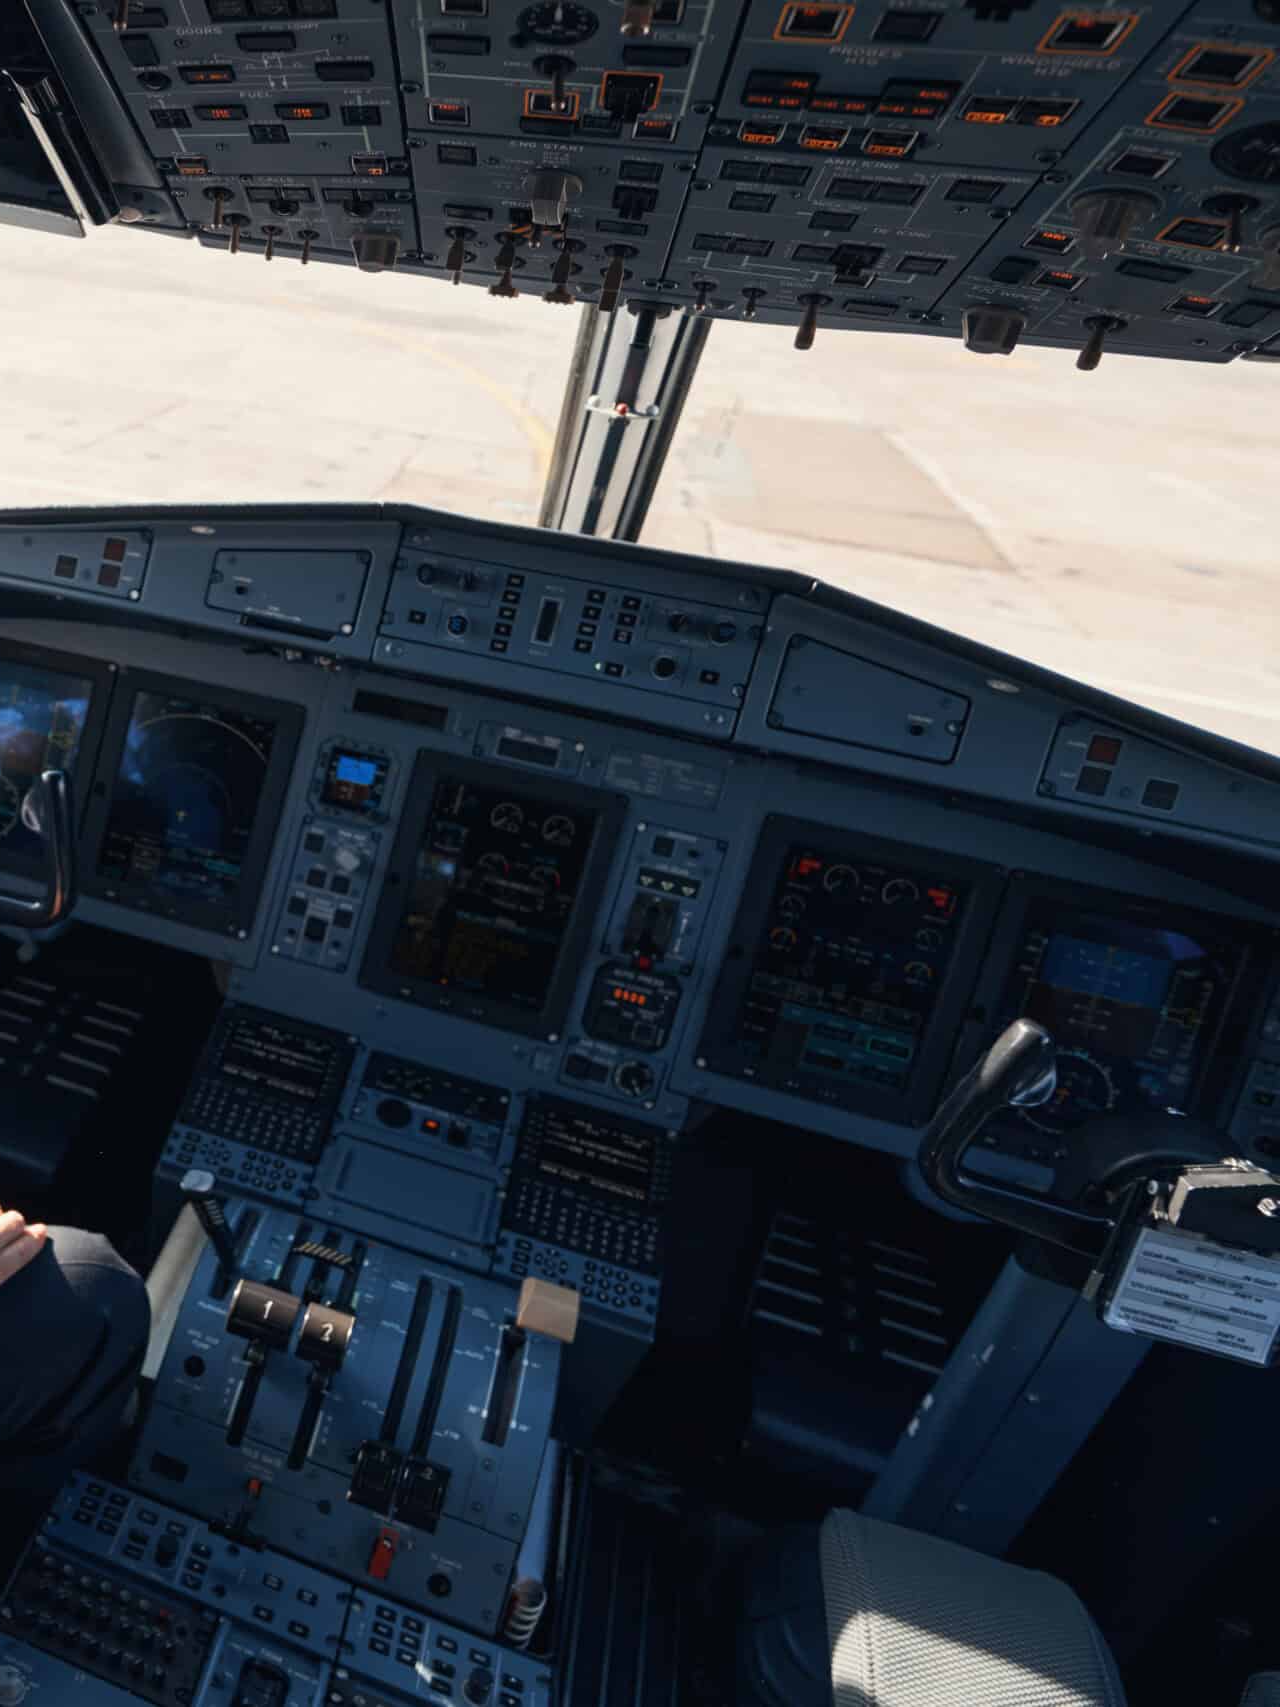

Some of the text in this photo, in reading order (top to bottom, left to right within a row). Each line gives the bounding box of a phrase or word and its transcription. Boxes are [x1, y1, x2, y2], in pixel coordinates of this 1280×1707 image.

[175, 24, 224, 35] DOORS
[239, 88, 274, 98] FUEL
[263, 1300, 274, 1320] 1
[320, 1323, 334, 1343] 2
